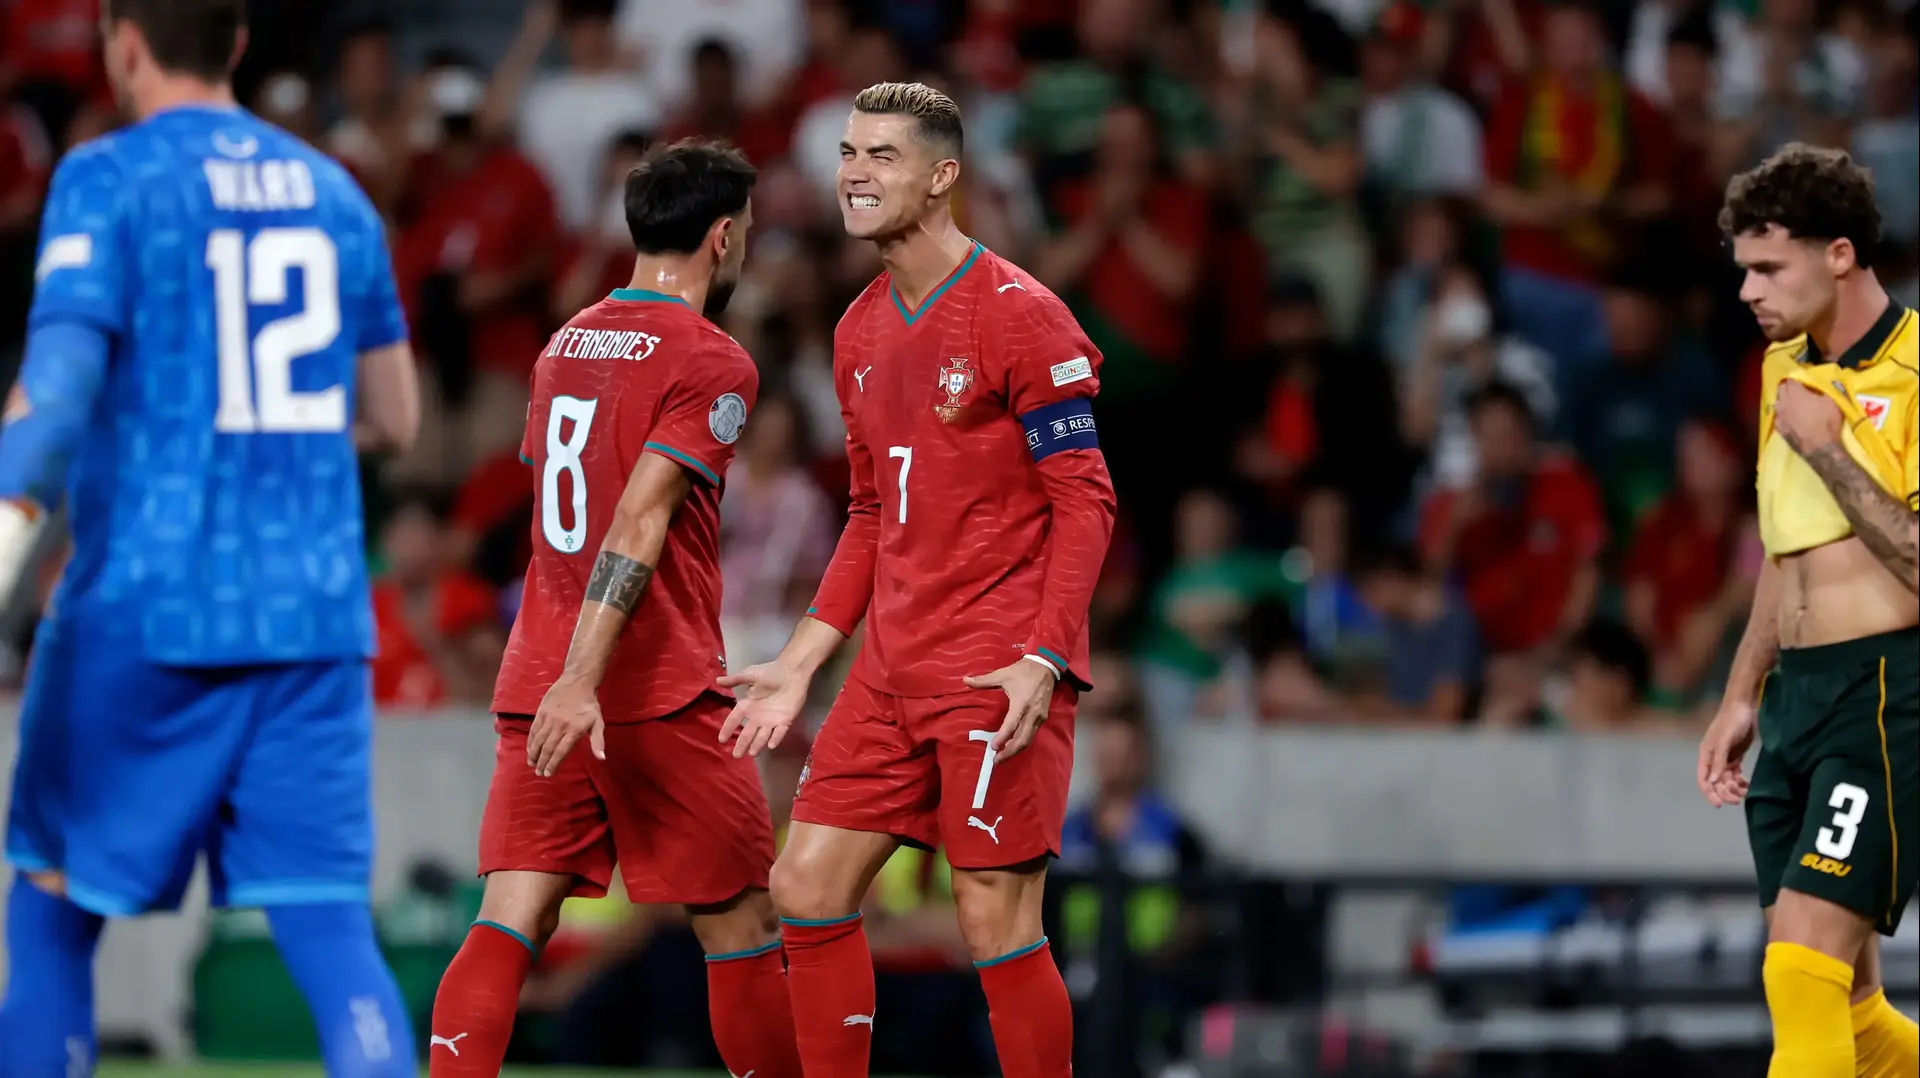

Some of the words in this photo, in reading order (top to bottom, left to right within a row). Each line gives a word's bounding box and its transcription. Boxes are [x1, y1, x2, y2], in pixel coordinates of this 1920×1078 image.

[204, 158, 316, 212] WARD
[206, 226, 346, 433] 12
[542, 394, 599, 554] 8
[888, 445, 913, 524] 7
[968, 729, 999, 809] 7
[1815, 782, 1869, 860] 3
